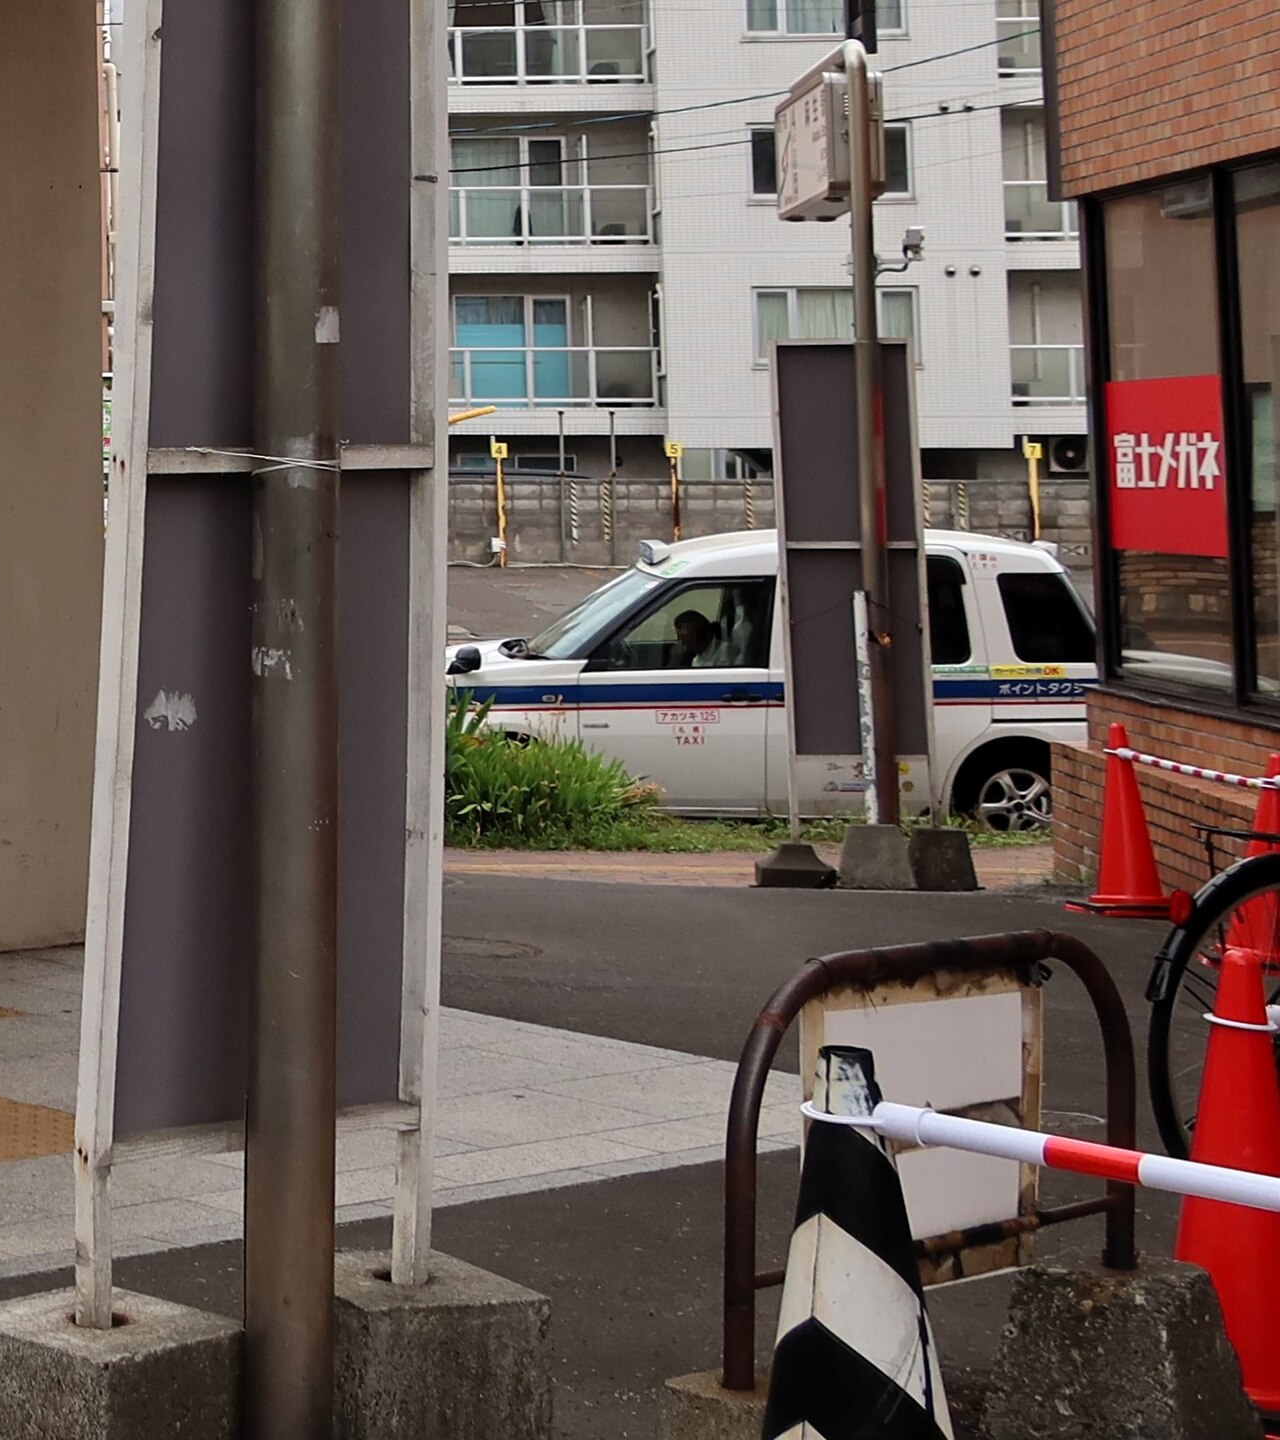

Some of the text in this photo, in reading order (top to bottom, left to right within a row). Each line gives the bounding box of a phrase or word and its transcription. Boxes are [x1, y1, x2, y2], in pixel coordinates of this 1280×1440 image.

[495, 445, 503, 456] 4
[670, 444, 678, 454] 5
[1029, 445, 1037, 456] 7
[1113, 432, 1221, 490] 富士メガネ
[700, 711, 716, 721] 125
[675, 736, 705, 745] TAXI
